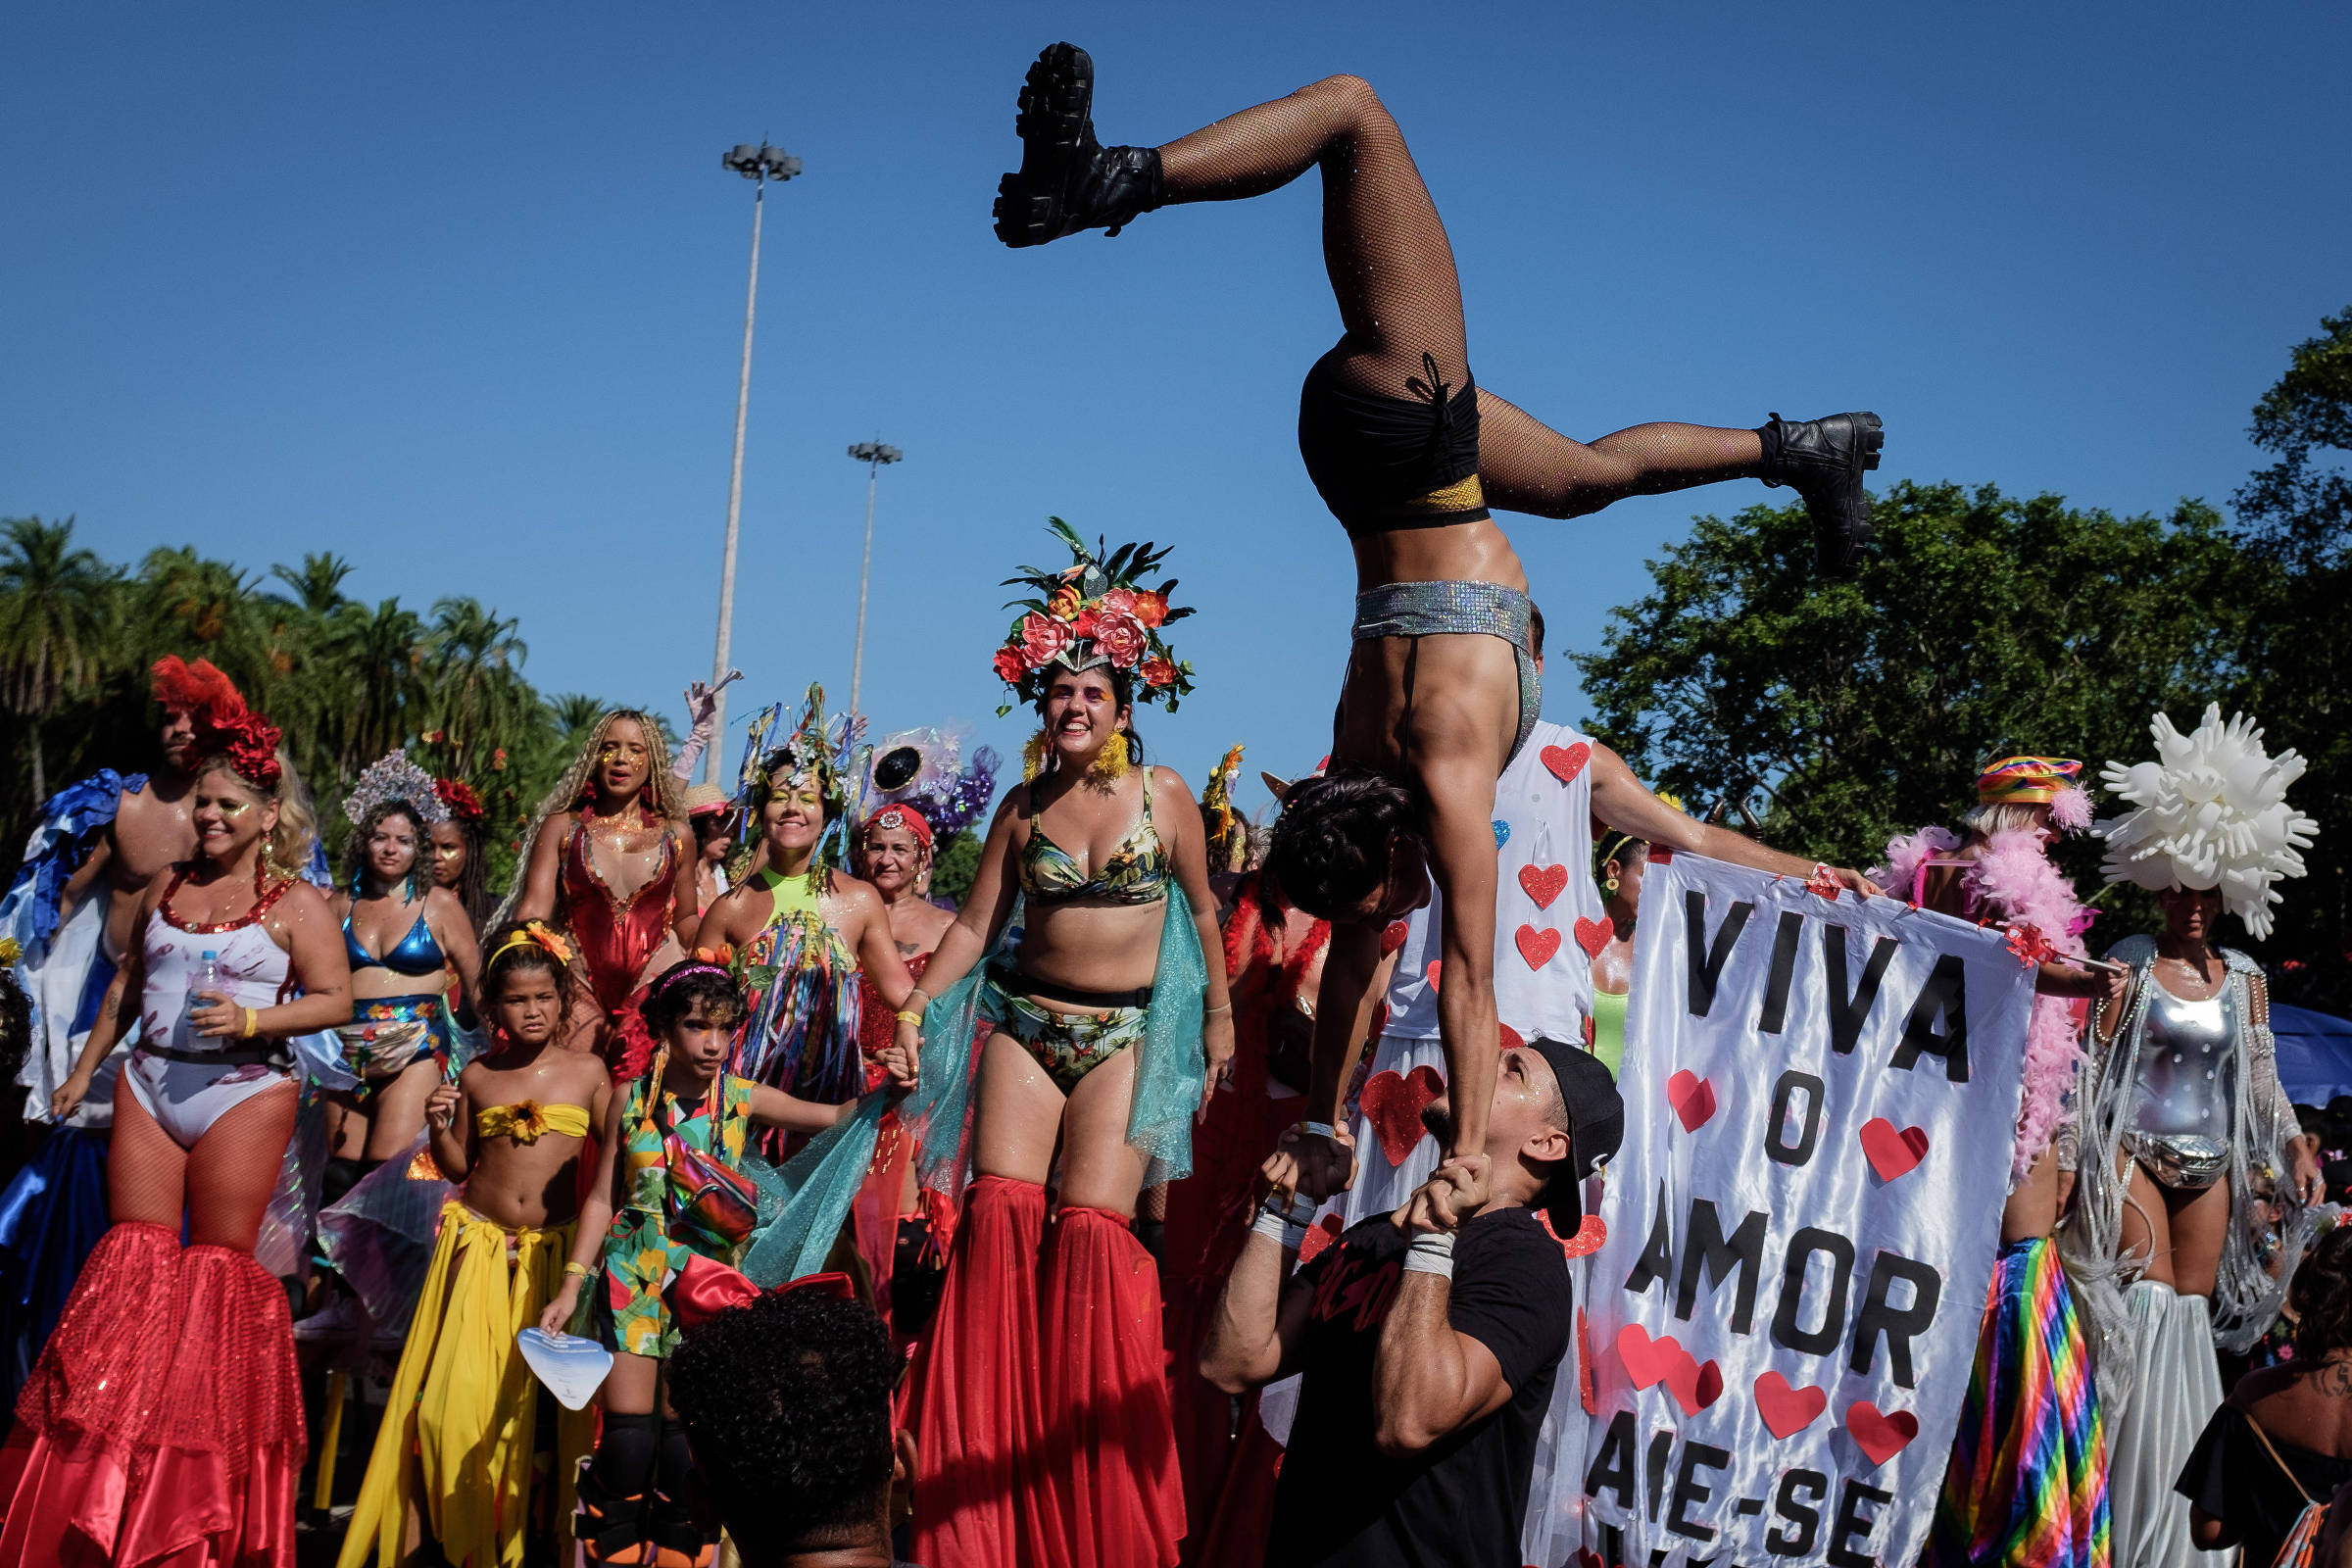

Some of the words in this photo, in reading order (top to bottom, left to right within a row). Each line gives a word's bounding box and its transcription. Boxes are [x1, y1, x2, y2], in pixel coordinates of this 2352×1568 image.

[1686, 890, 1970, 1084] VIVA
[1764, 1069, 1825, 1166] O
[1624, 1176, 1942, 1390] AMOR
